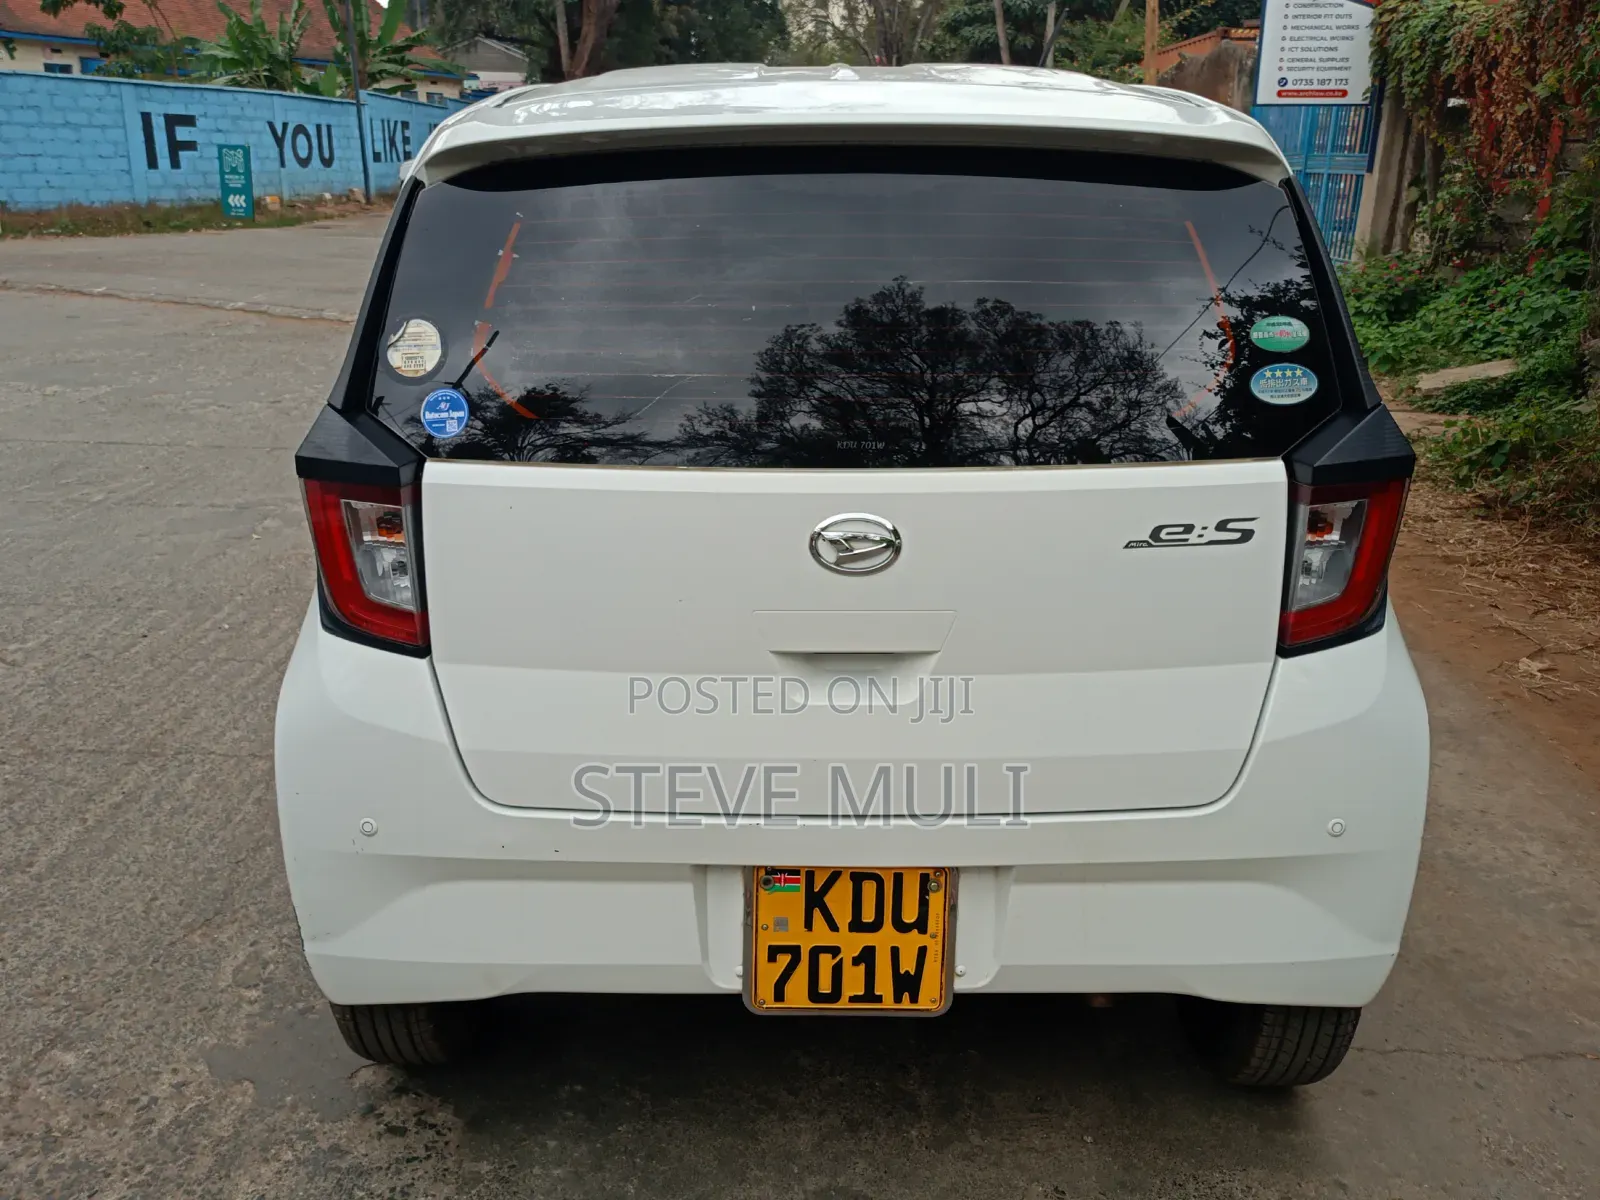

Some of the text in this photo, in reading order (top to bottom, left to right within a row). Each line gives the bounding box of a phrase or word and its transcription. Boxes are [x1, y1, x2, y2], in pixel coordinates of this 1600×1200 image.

[1291, 78, 1349, 86] 0735 187 173
[140, 111, 413, 170] IF YOU LIKE
[837, 441, 885, 450] KDU 701W
[803, 869, 931, 935] KDU
[767, 944, 928, 1004] 701W
